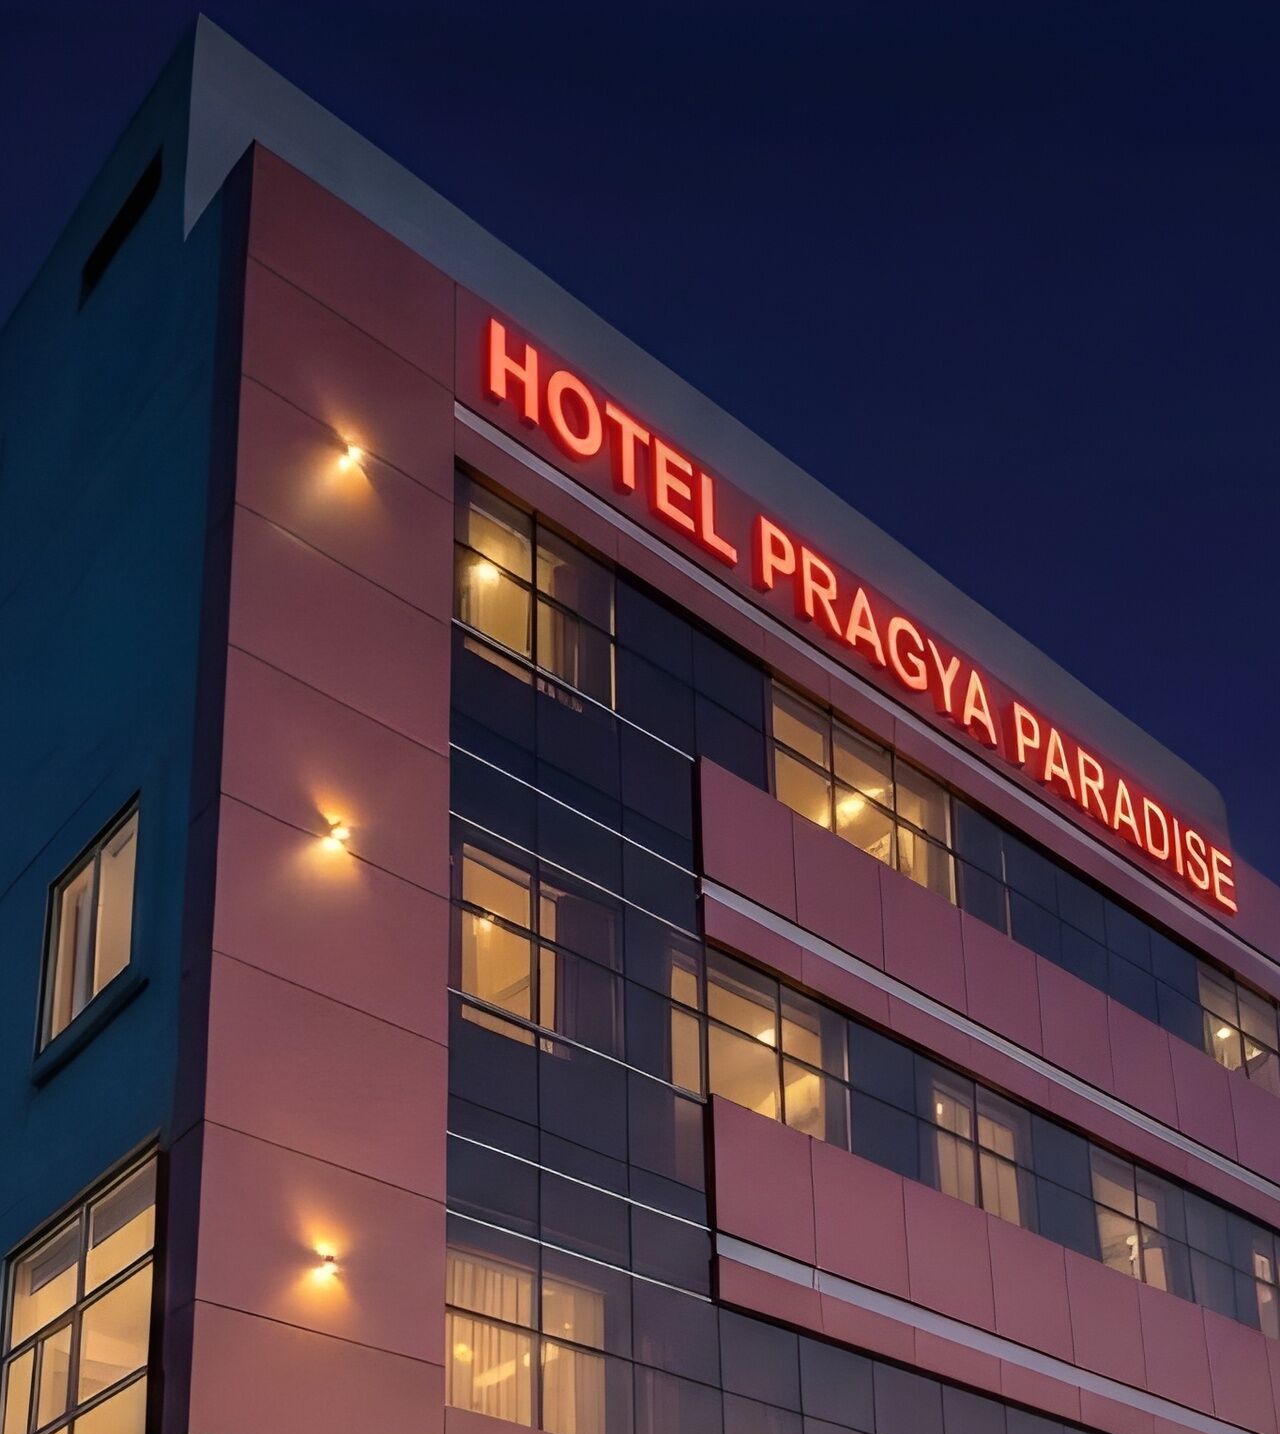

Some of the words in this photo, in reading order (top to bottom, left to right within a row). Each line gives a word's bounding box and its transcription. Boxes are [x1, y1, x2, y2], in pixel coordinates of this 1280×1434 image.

[489, 317, 738, 565] HOTEL
[755, 514, 998, 746] PRAGYA
[1011, 700, 1239, 914] PARADISE
